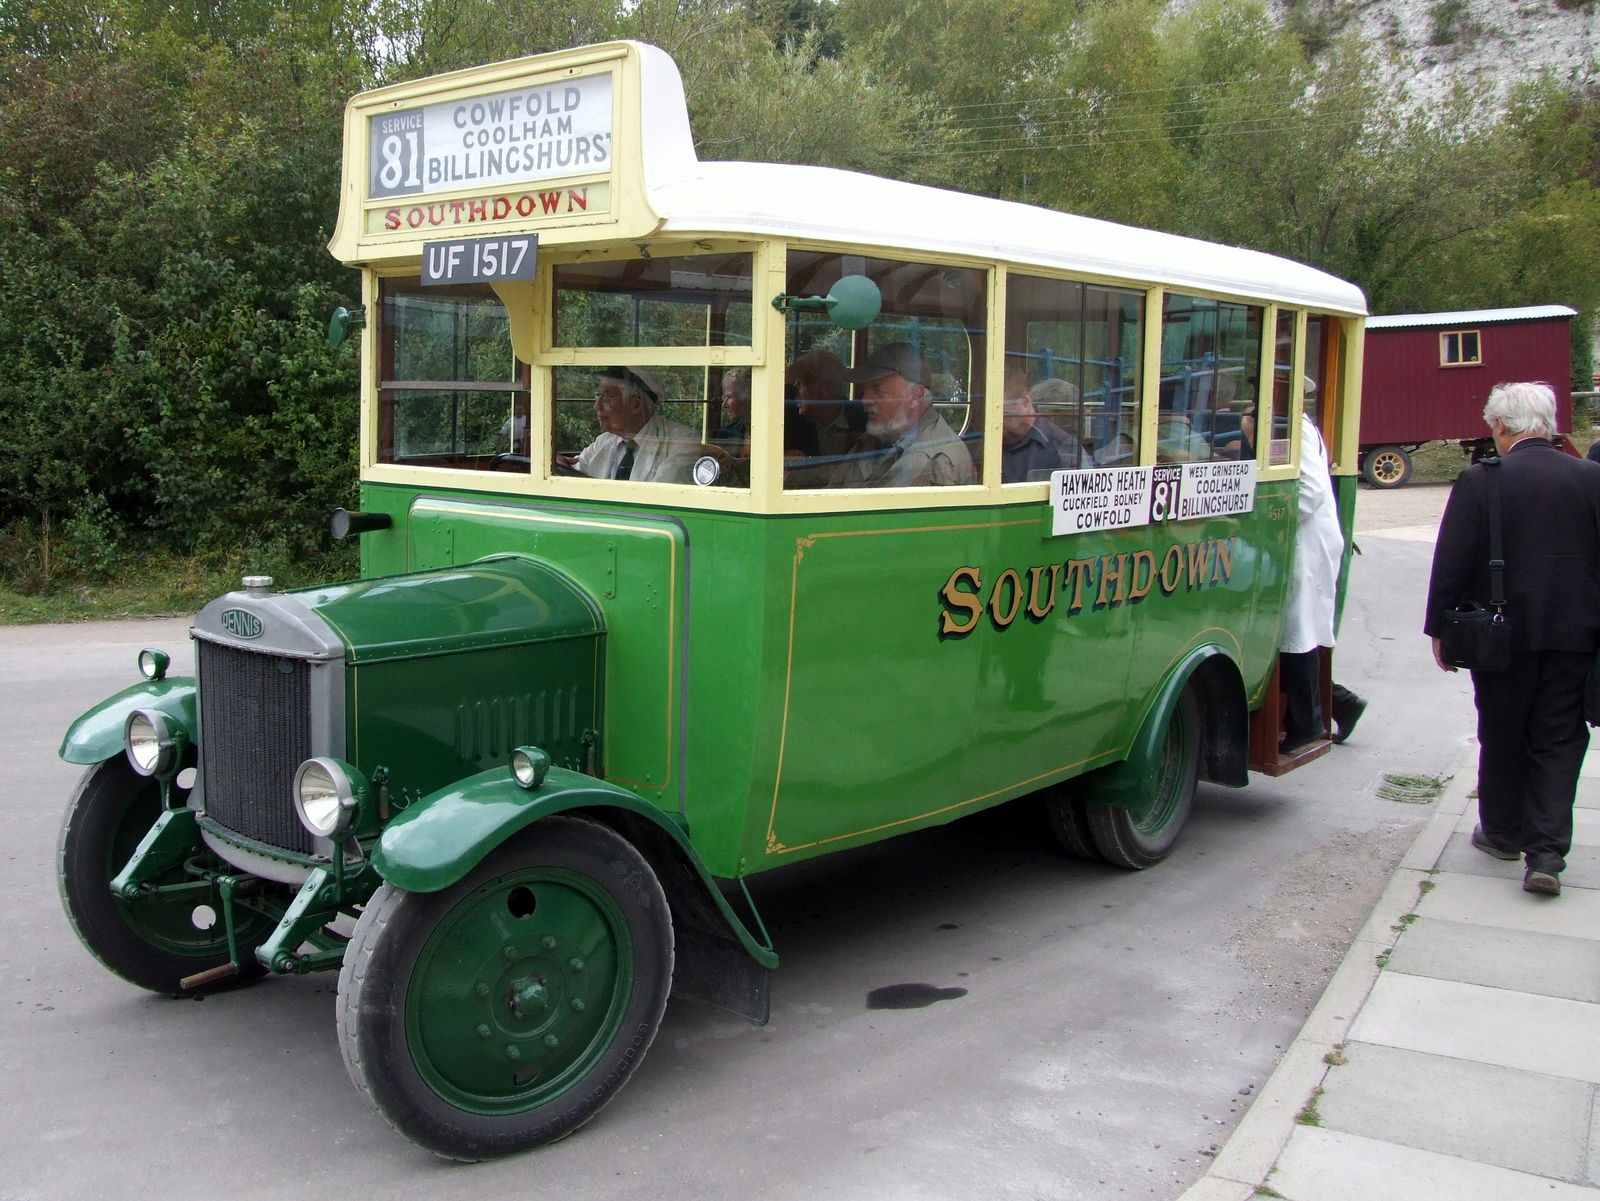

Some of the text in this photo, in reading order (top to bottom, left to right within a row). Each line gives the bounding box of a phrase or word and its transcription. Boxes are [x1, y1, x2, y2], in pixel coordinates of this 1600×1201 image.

[453, 87, 581, 129] COWFOLD
[382, 113, 422, 134] SERVICE
[462, 115, 572, 149] COOLHAM
[380, 131, 421, 189] 81
[385, 187, 589, 230] SOUTHDOWN
[429, 240, 529, 279] UF 1517
[1061, 470, 1147, 496] HAYWARDS HEATH
[1153, 468, 1181, 482] SERVICE
[1189, 464, 1249, 478] WEST GRINSTEAD
[1196, 478, 1240, 494] COOLHAM
[1114, 492, 1144, 507] BOLNEY
[1152, 481, 1178, 522] 81
[1181, 493, 1249, 518] BILLINGSHURST
[1076, 508, 1131, 530] COWFOLD
[937, 536, 1236, 642] SOUTHDOWN
[222, 610, 262, 636] DENNIS
